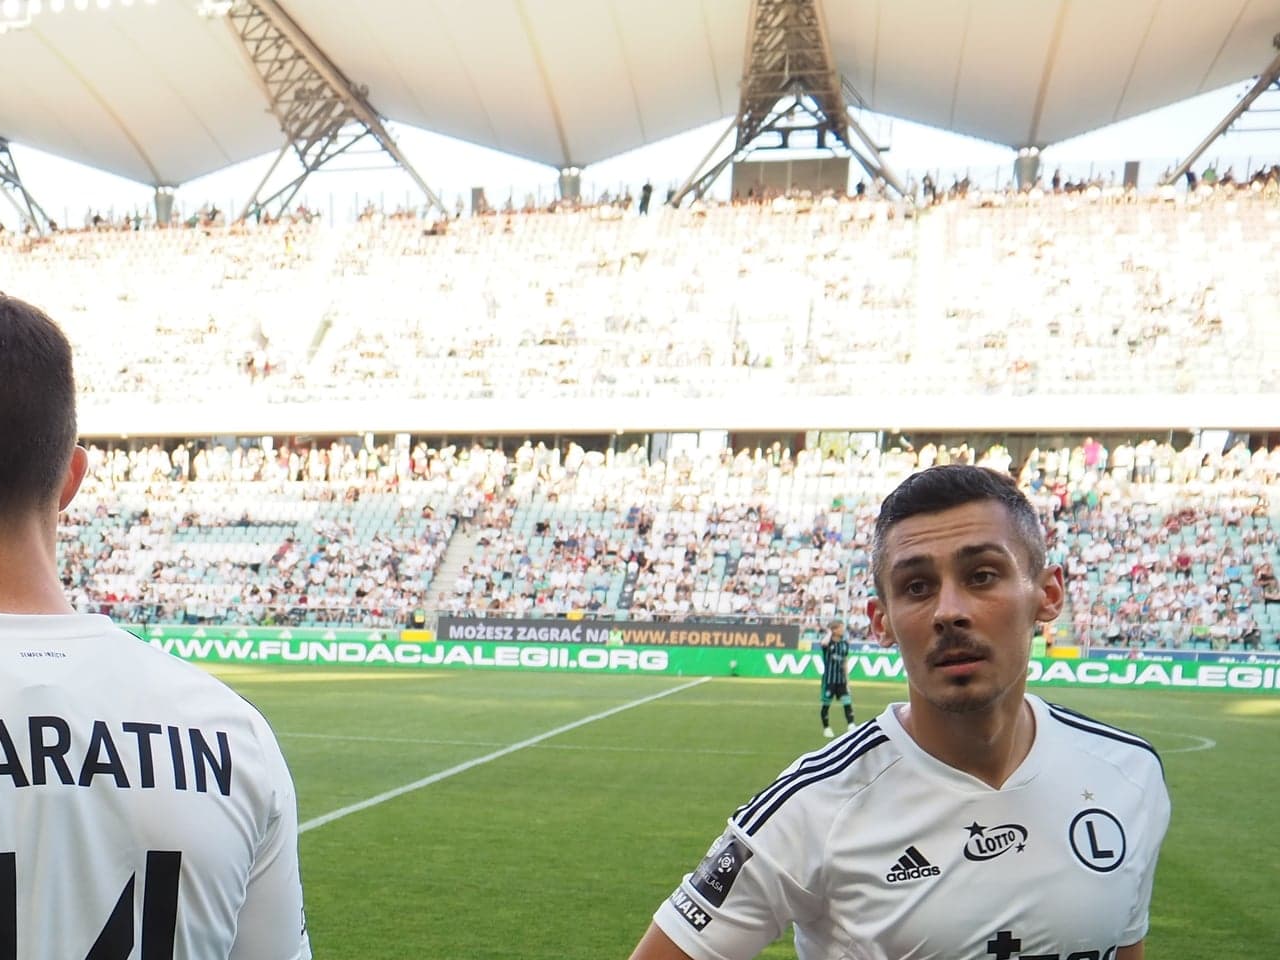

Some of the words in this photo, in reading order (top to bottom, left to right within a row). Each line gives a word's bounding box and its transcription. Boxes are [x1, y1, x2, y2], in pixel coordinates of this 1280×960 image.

[449, 622, 513, 640] MOŻESZ
[517, 624, 583, 641] ZAGRAĆ
[975, 830, 1016, 854] LOTTO
[1086, 820, 1114, 859] L
[886, 865, 941, 883] adidas
